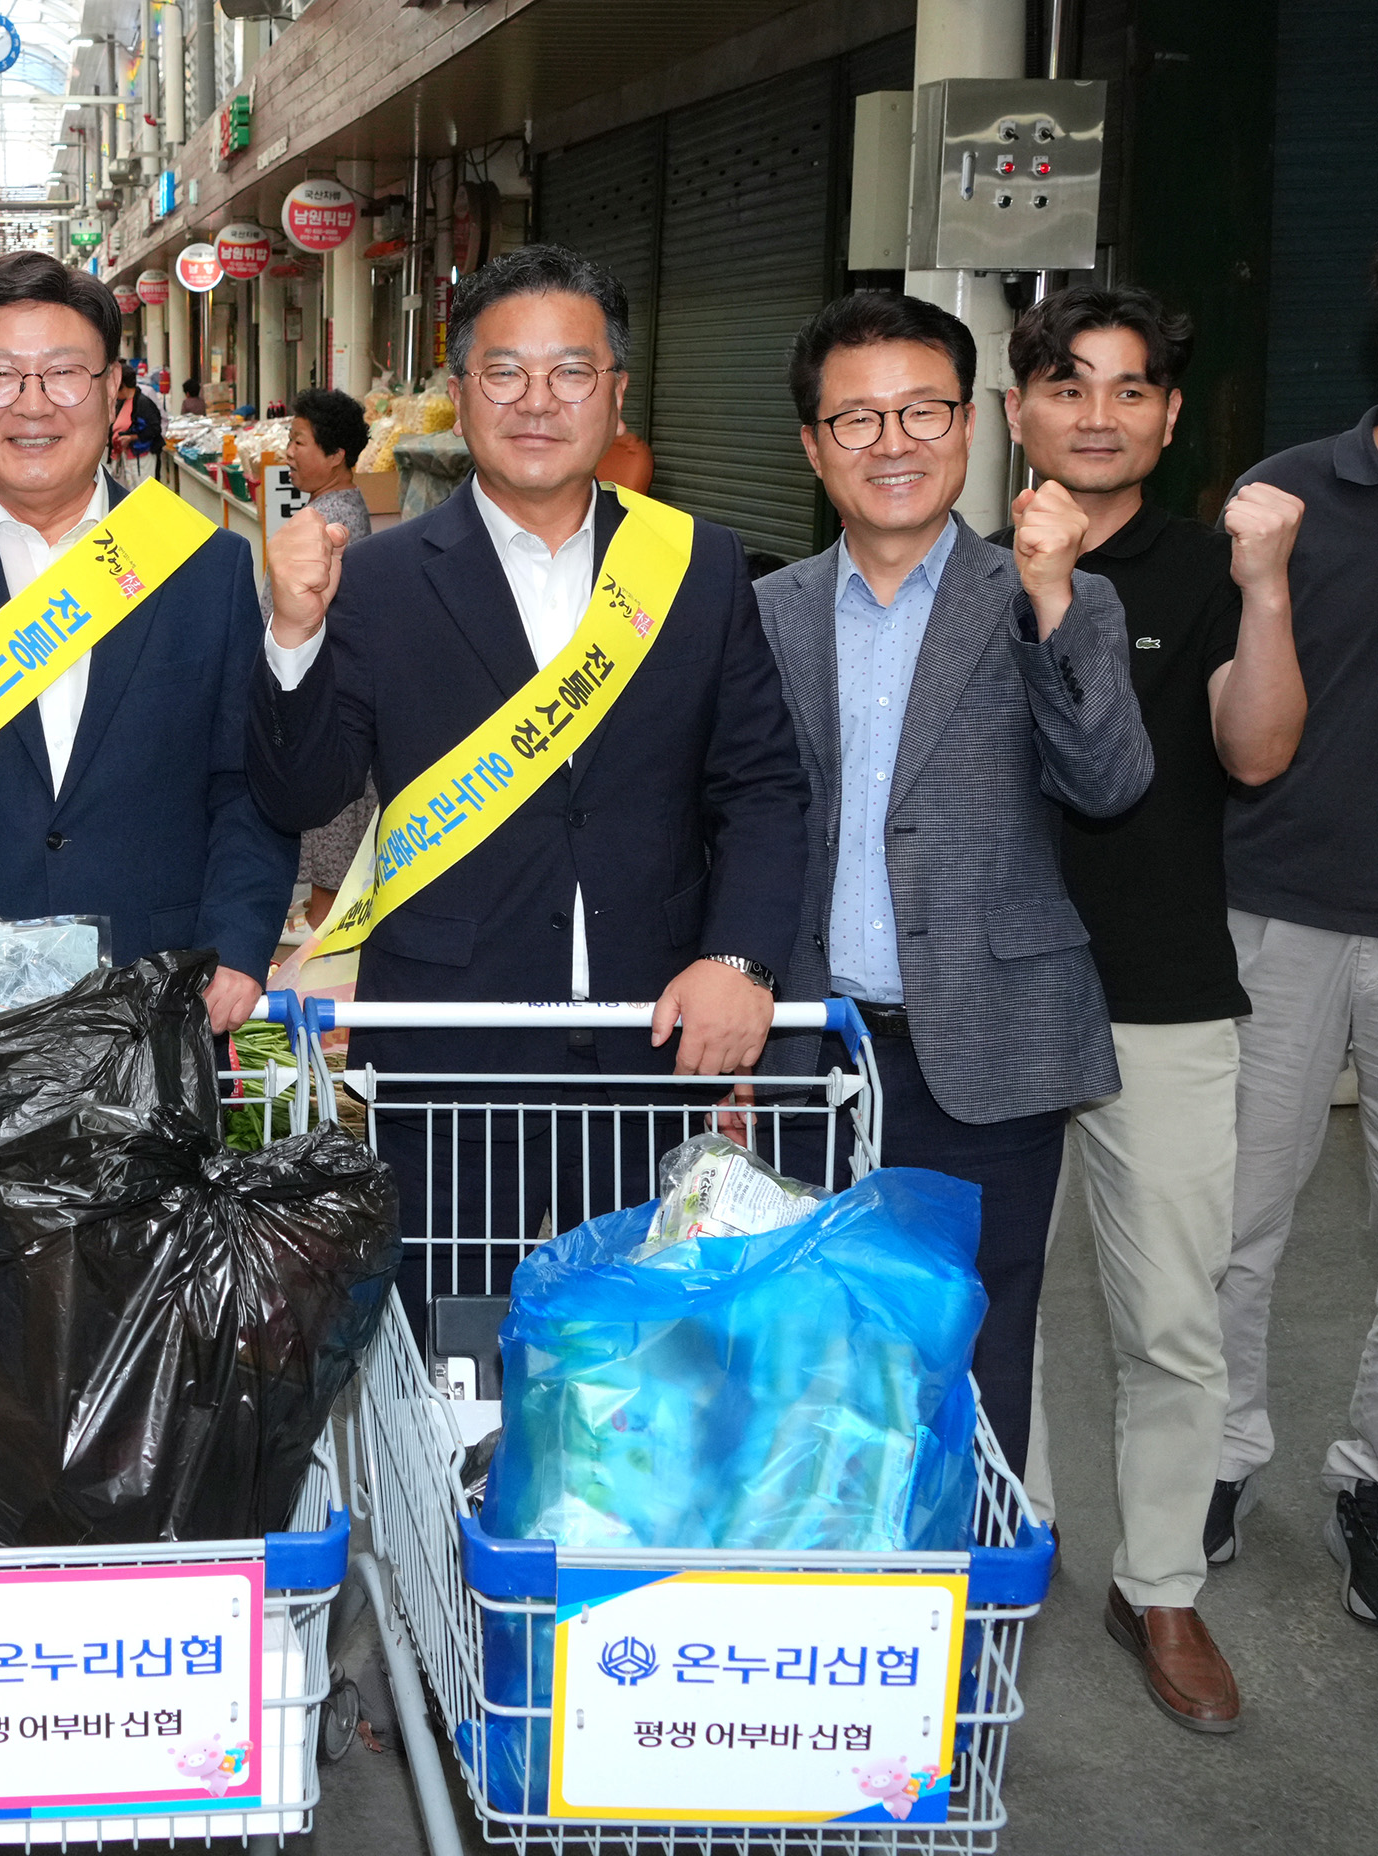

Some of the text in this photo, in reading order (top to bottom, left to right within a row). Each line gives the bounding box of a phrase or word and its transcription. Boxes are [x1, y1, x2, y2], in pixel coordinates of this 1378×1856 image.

[294, 209, 352, 227] 남원튀밥
[221, 246, 269, 262] 남원튀밥
[512, 644, 615, 760] 전통시장
[672, 1643, 920, 1687] 온누리신협
[19, 1712, 116, 1742] 어부바
[121, 1709, 183, 1738] 신협
[634, 1721, 873, 1752] 평생 어부바 신협
